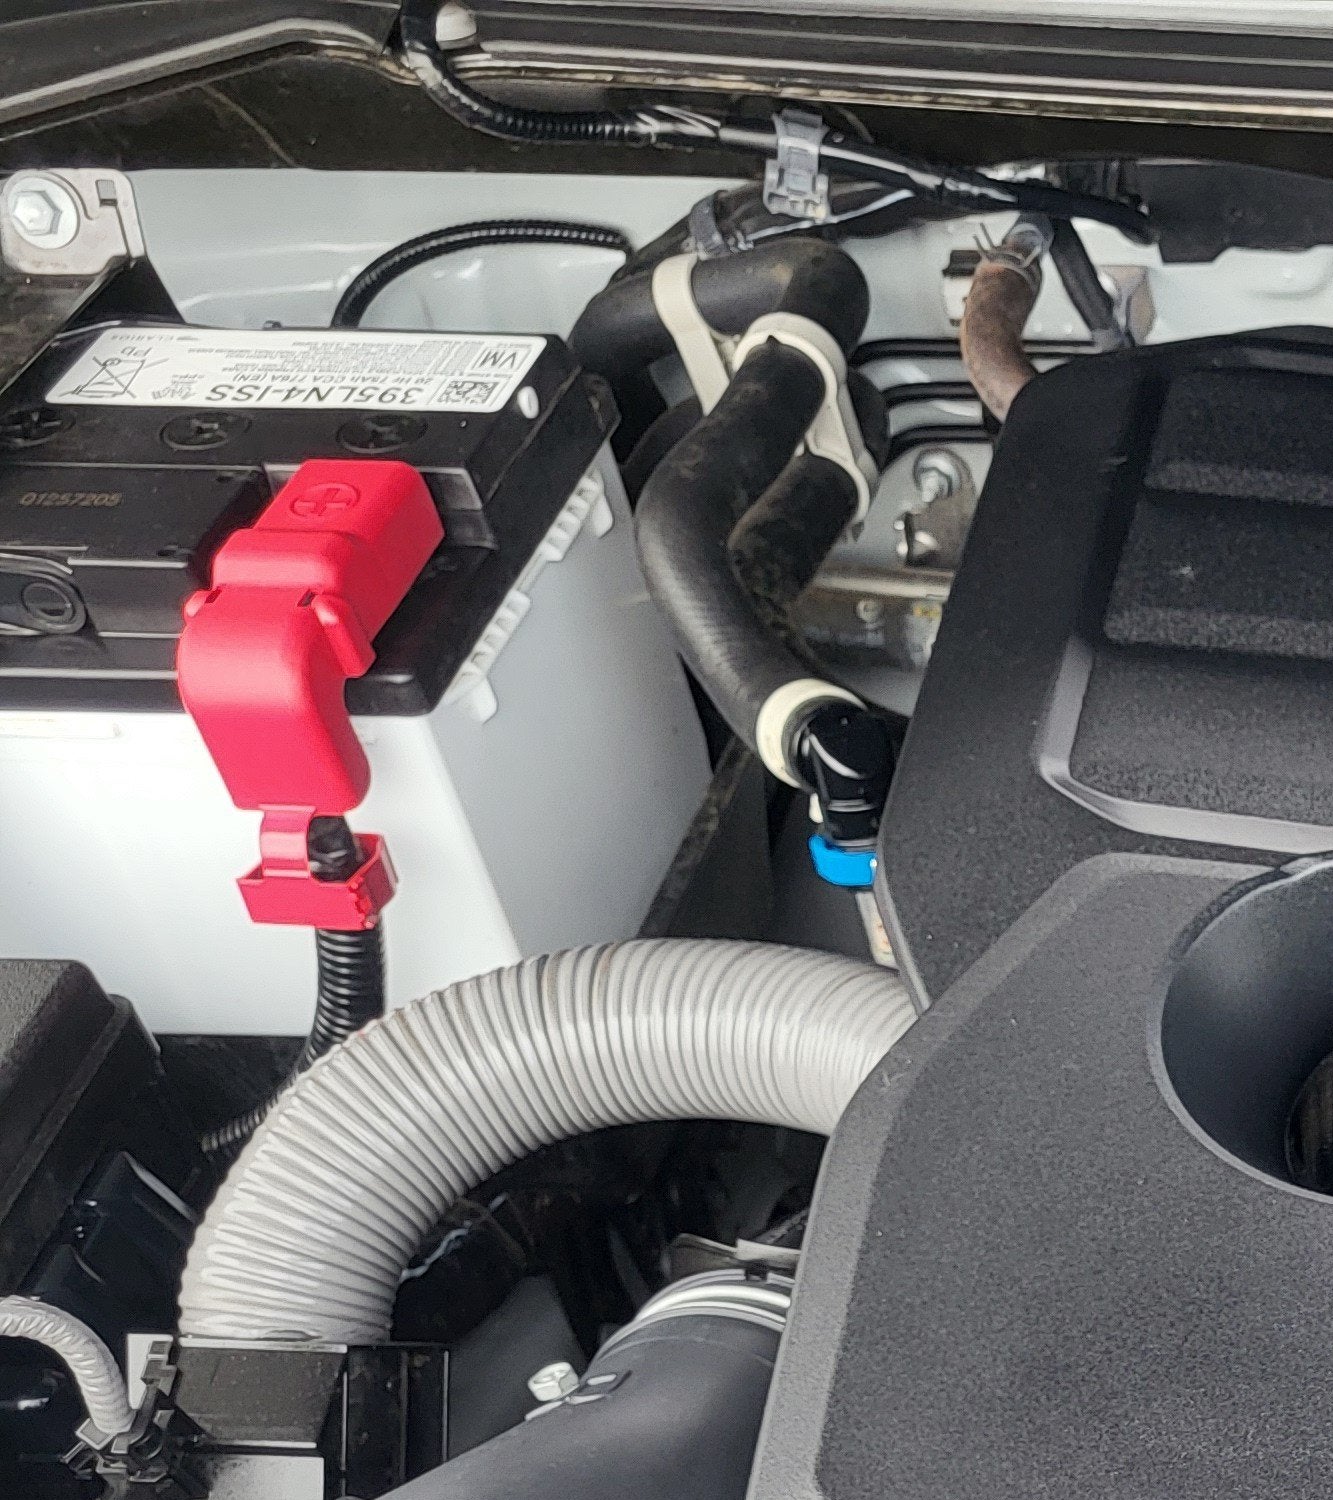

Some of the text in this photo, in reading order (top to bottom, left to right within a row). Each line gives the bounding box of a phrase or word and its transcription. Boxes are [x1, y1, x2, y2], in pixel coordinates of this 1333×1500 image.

[480, 350, 519, 370] VM
[312, 374, 348, 384] CCA
[206, 385, 423, 404] 395LN4-ISS
